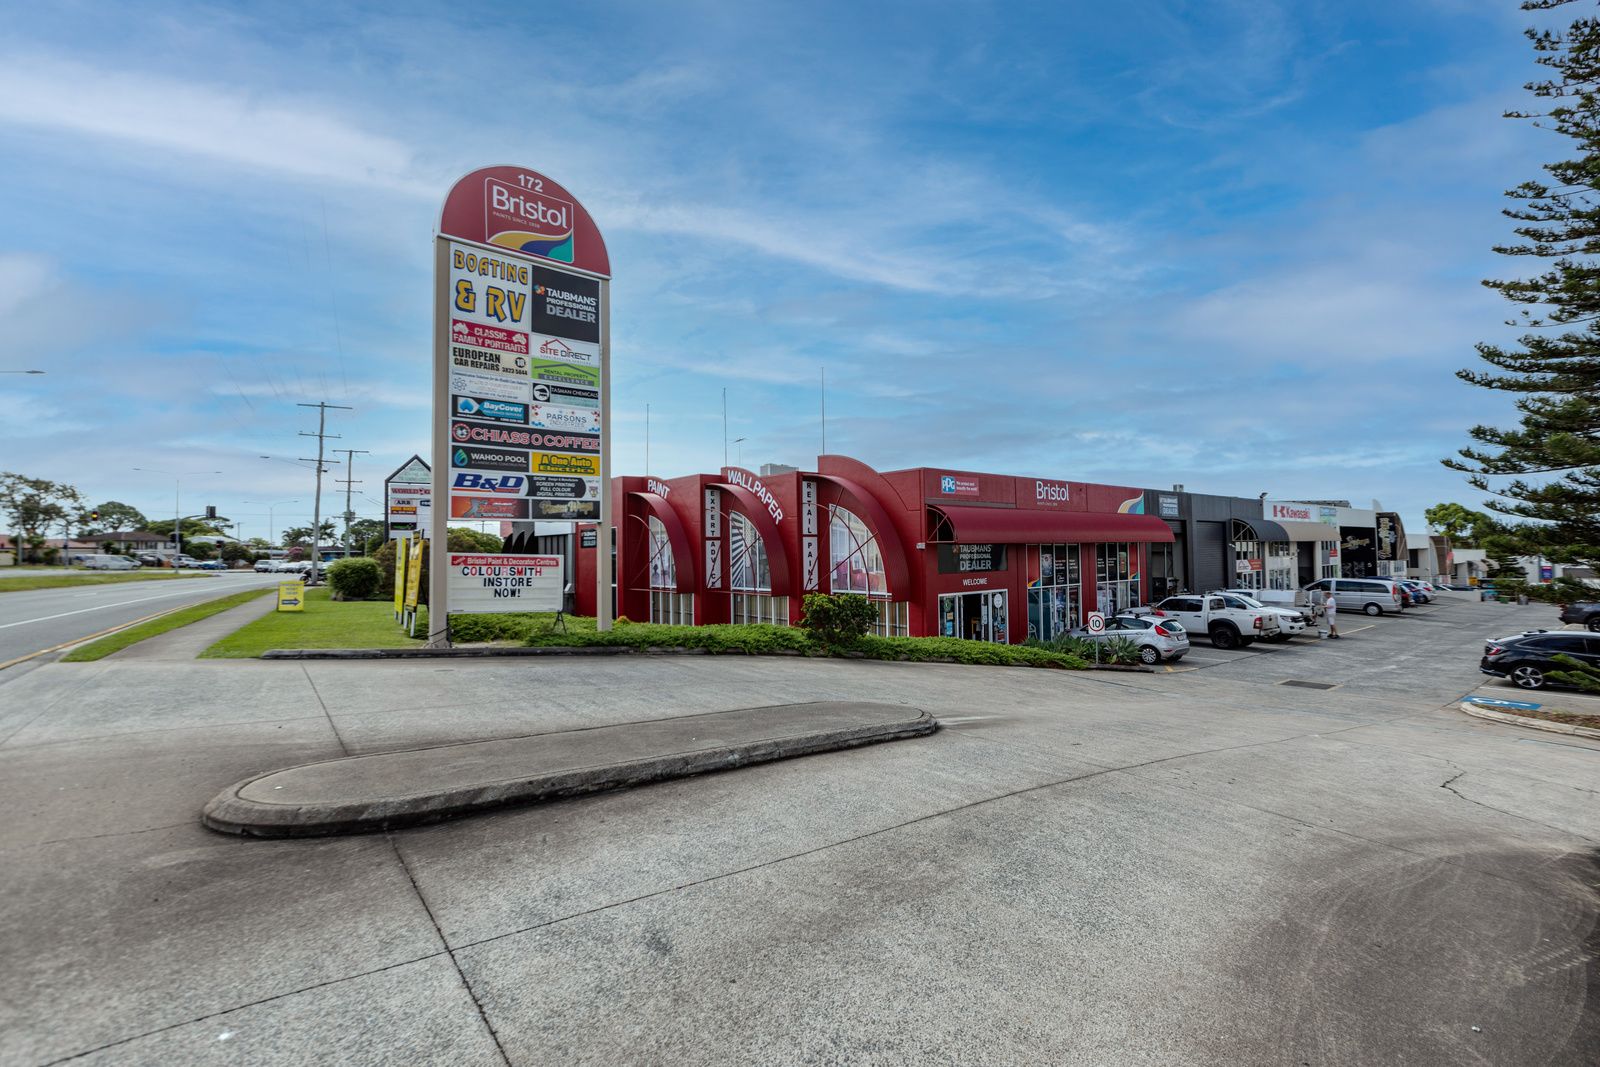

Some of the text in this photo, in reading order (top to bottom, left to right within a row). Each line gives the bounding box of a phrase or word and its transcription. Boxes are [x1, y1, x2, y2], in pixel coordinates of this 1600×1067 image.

[518, 174, 543, 192] 172
[492, 185, 567, 228] Bristol
[454, 249, 528, 285] BOATING
[455, 279, 526, 323] & RV
[546, 287, 596, 306] TAUBMANS
[546, 297, 596, 313] PROFESSIONAL
[546, 304, 596, 324] DEALER
[474, 327, 507, 341] CLASSIC
[453, 333, 527, 353] FAMILY PORTRAITS
[452, 347, 501, 364] EUROPEAN
[540, 346, 559, 356] SITE
[560, 350, 592, 361] DIRECT
[454, 358, 469, 367] CAR
[470, 360, 500, 372] REPAIRS
[546, 413, 587, 424] PARSONS
[544, 434, 600, 450] COFFEE
[470, 452, 503, 462] WAHOO
[541, 454, 550, 465] A
[570, 456, 592, 468] Auto
[648, 480, 670, 499] PAINT
[1036, 480, 1070, 501] Bristol
[728, 470, 783, 525] WALLPAPER
[960, 544, 992, 553] TAUBMANS
[467, 557, 486, 565] Bristol
[960, 560, 992, 570] DEALER
[484, 578, 532, 587] INSTORE
[963, 578, 987, 586] WELCOME
[494, 588, 521, 598] NOW!
[1092, 620, 1100, 628] 10
